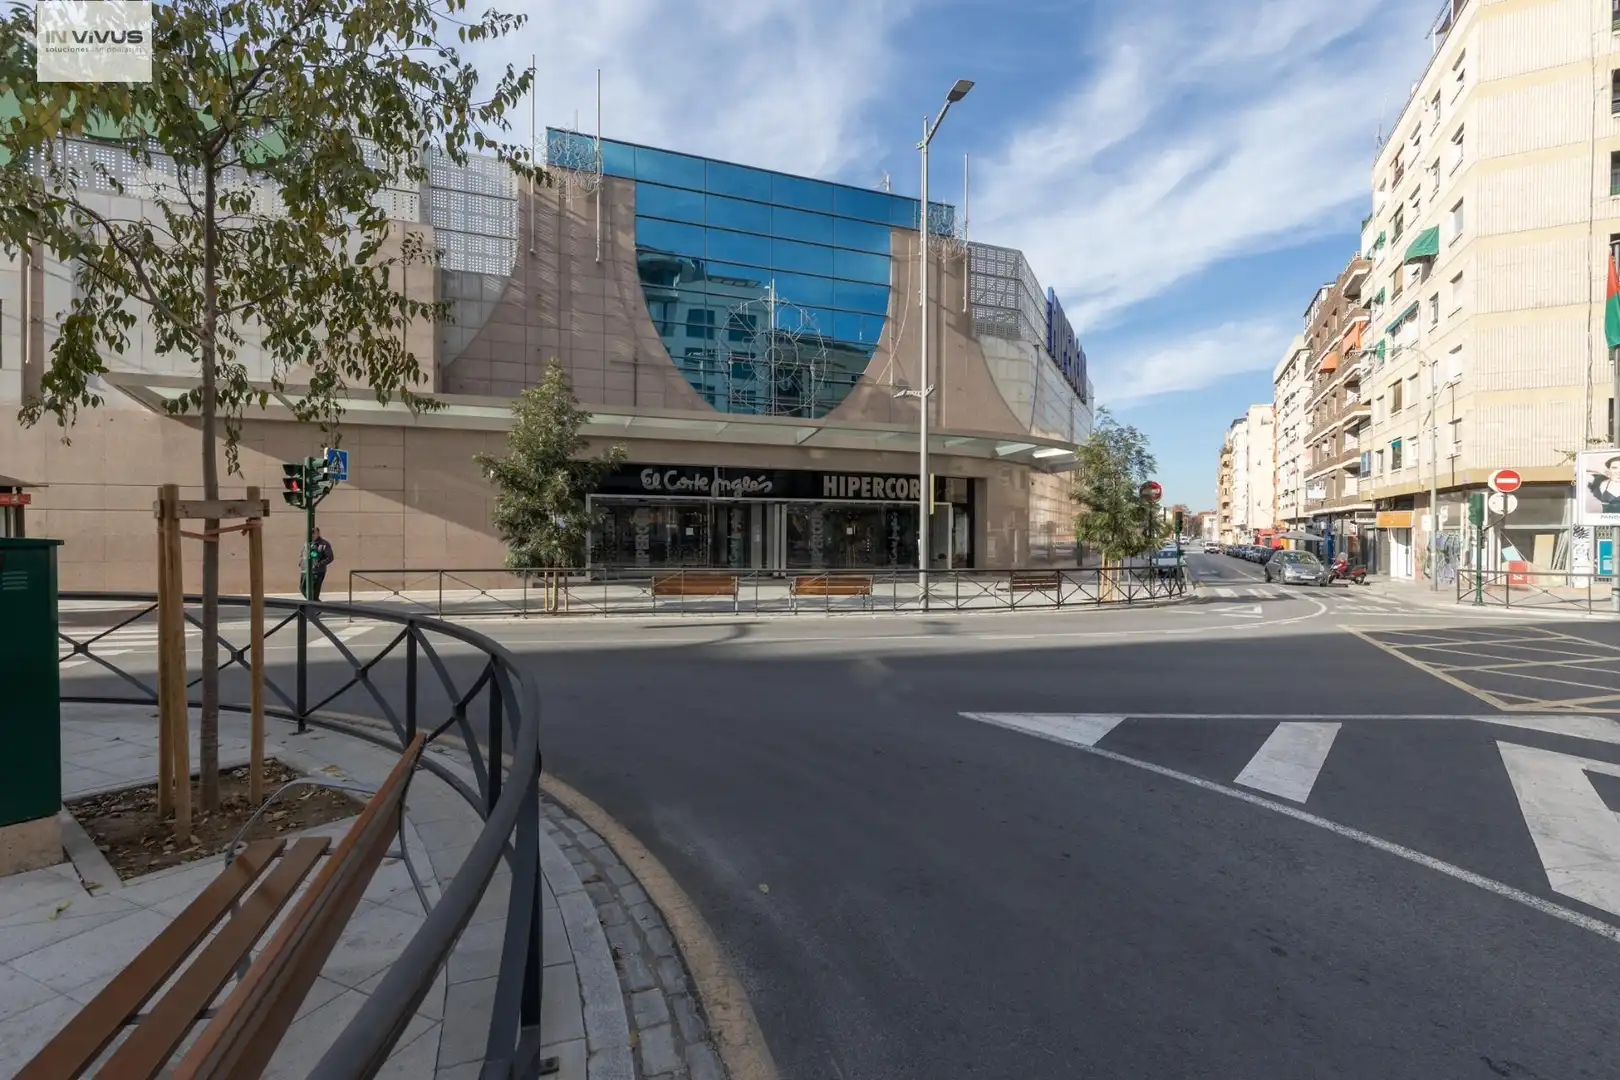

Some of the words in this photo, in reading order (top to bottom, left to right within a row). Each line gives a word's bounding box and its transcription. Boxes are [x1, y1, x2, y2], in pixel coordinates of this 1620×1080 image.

[640, 468, 661, 490] El
[663, 469, 710, 491] Corte
[711, 466, 773, 498] Inglés
[823, 475, 920, 499] HIPERCOR
